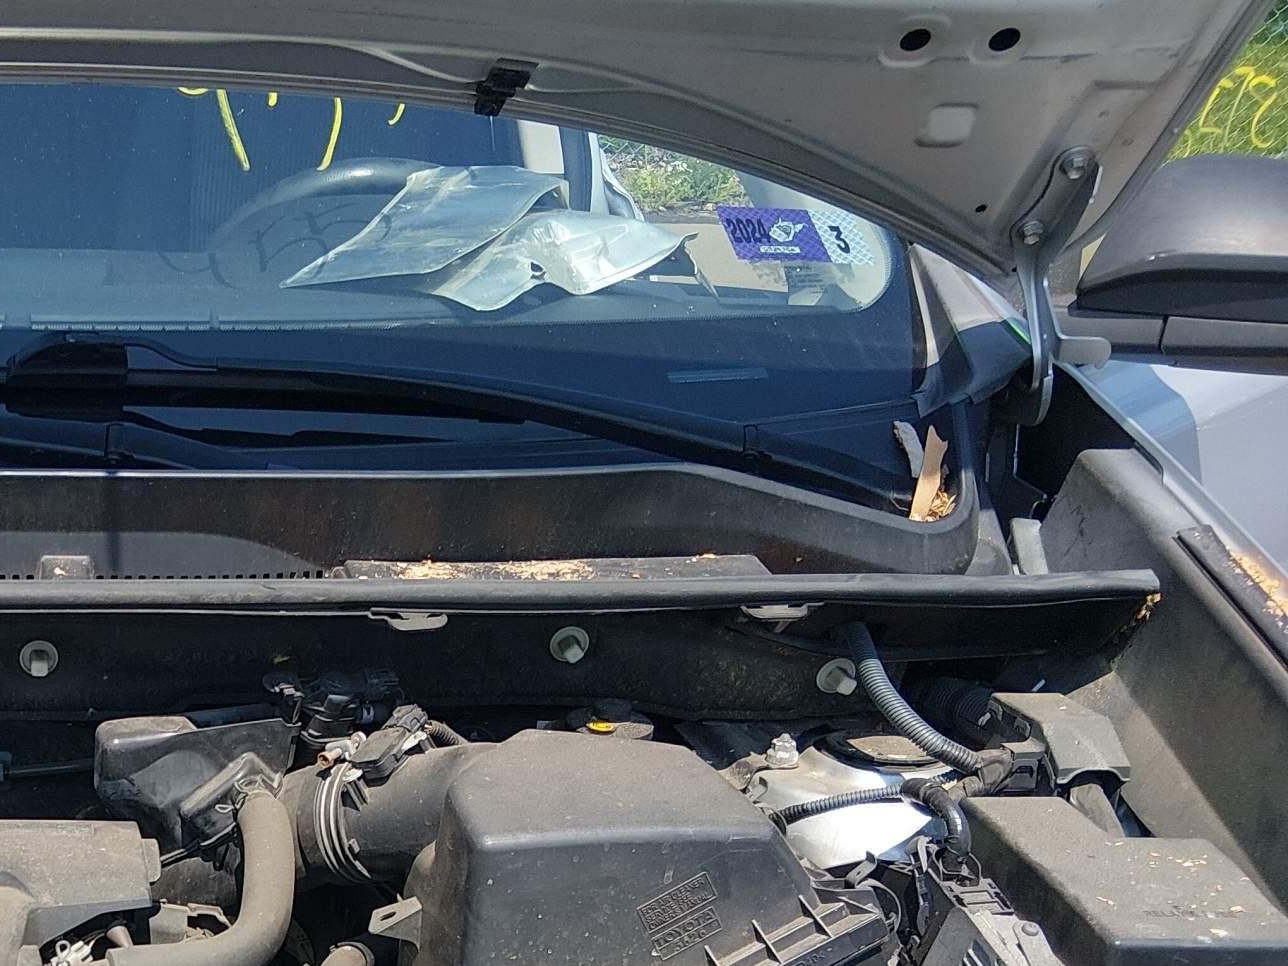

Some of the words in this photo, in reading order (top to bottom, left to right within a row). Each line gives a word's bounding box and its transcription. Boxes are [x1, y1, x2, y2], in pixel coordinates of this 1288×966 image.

[726, 217, 771, 244] 2024
[827, 225, 851, 254] 3
[653, 909, 715, 948] TOYOTA
